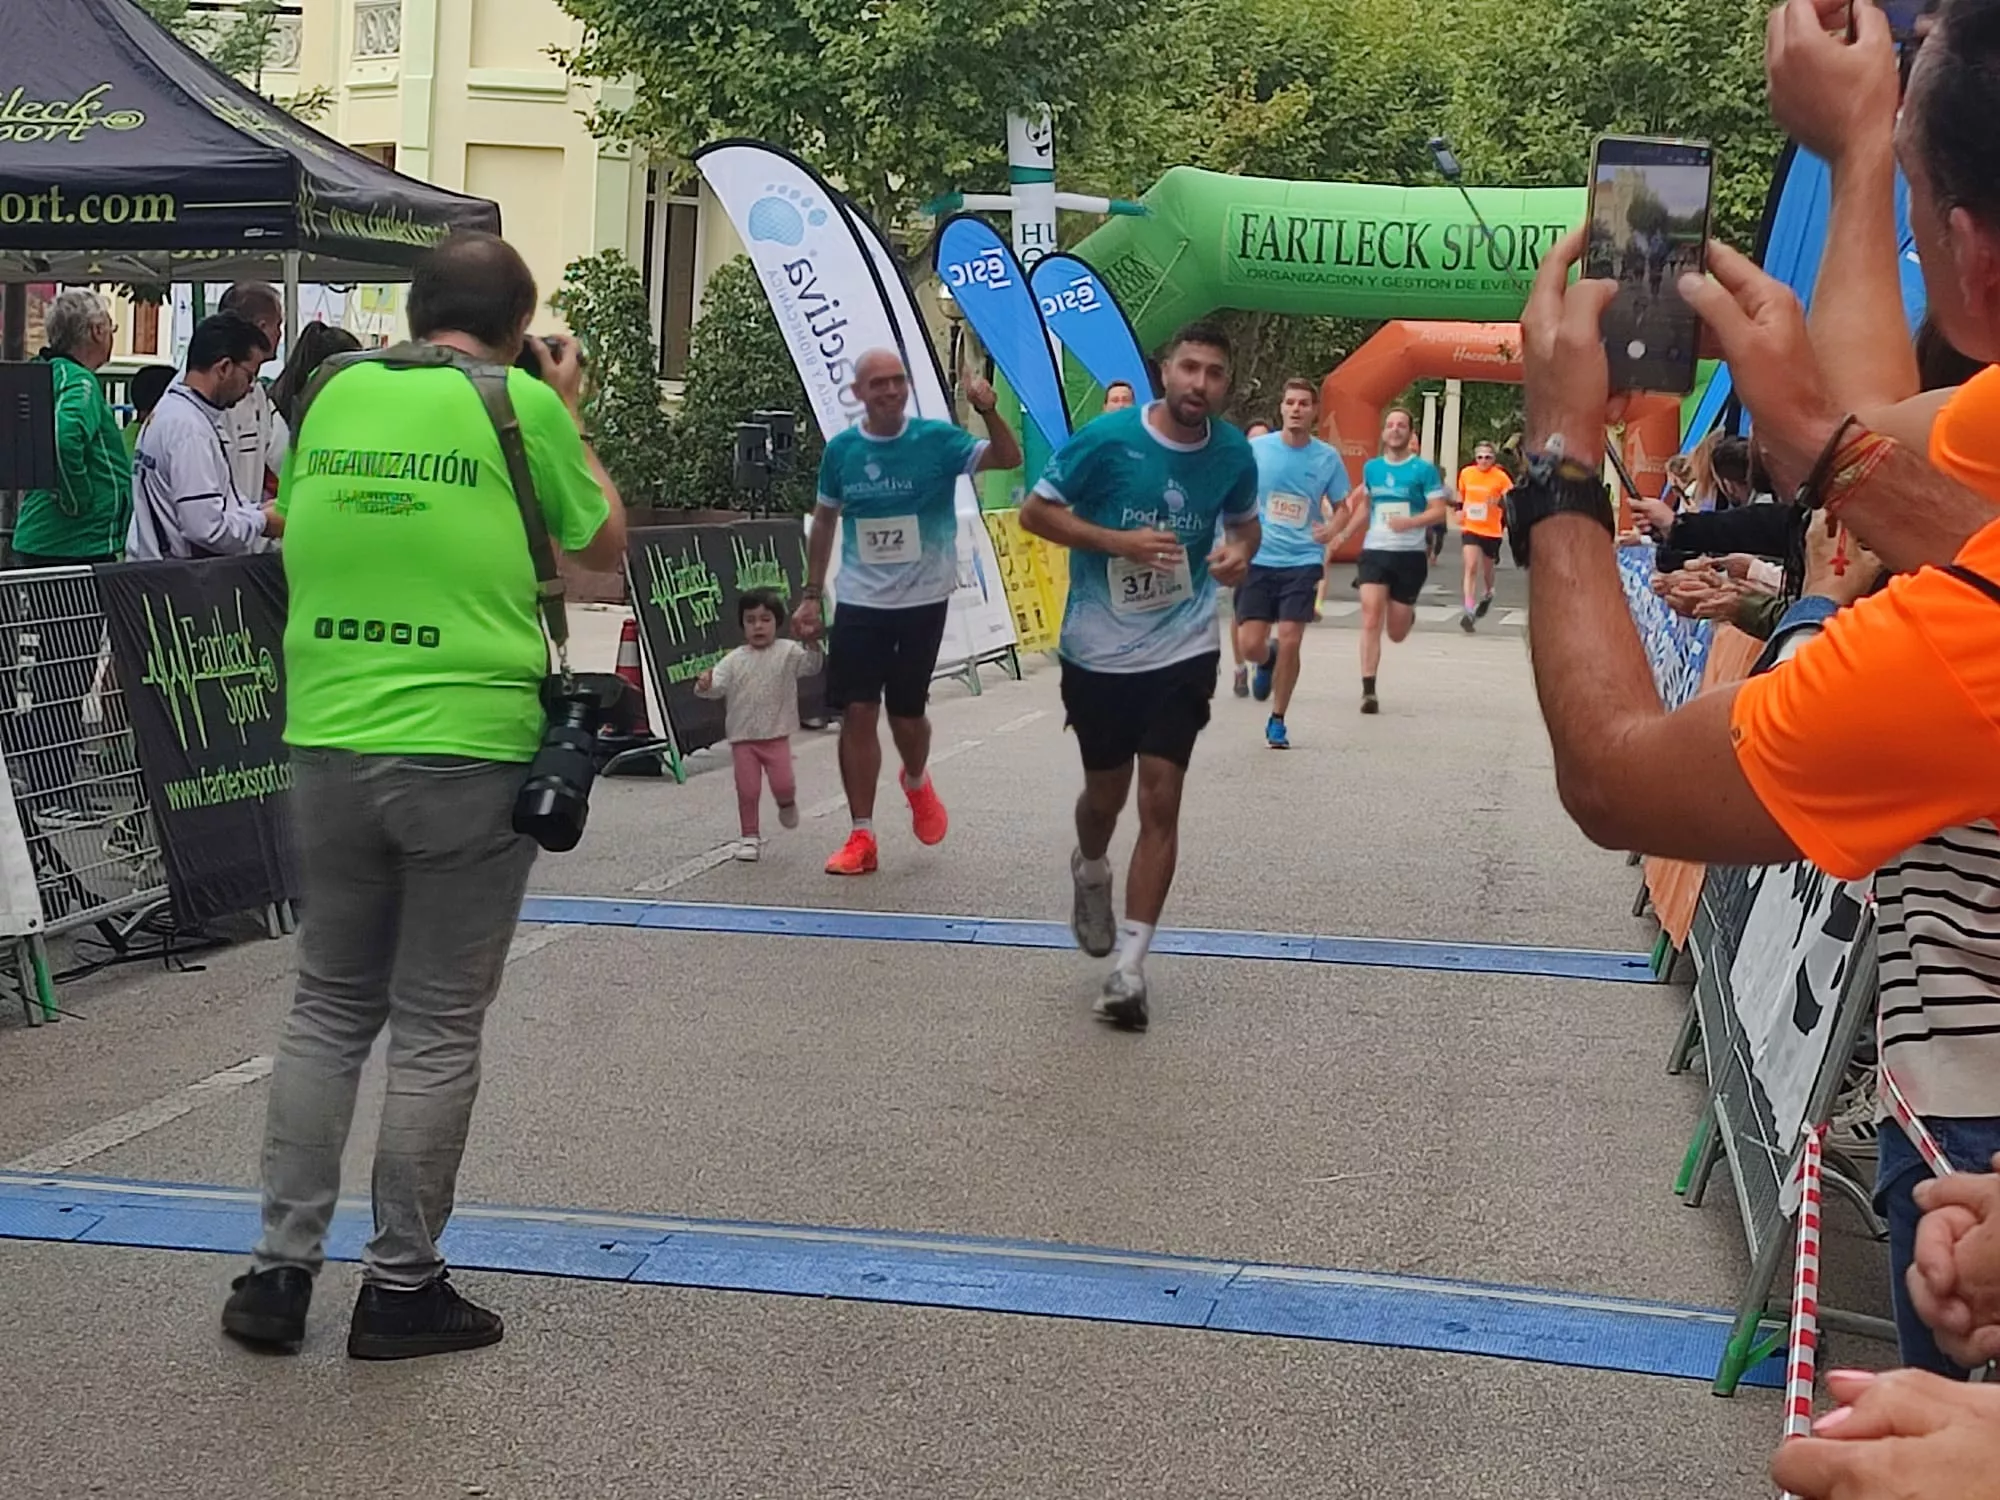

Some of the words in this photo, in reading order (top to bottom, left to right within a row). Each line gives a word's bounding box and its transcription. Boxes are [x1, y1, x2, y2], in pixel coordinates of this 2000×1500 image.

[0, 82, 113, 122] leck
[1238, 213, 1431, 270] FARTLECK
[1441, 223, 1567, 272] SPORT
[1247, 268, 1363, 287] ORGANIZACION
[1367, 276, 1378, 287] Y
[1382, 276, 1451, 289] GESTION
[1455, 279, 1477, 290] DE
[307, 448, 479, 488] ORGANIZACIÓN
[866, 529, 904, 546] 372
[180, 587, 256, 675] Fartleck
[221, 673, 271, 745] Sport
